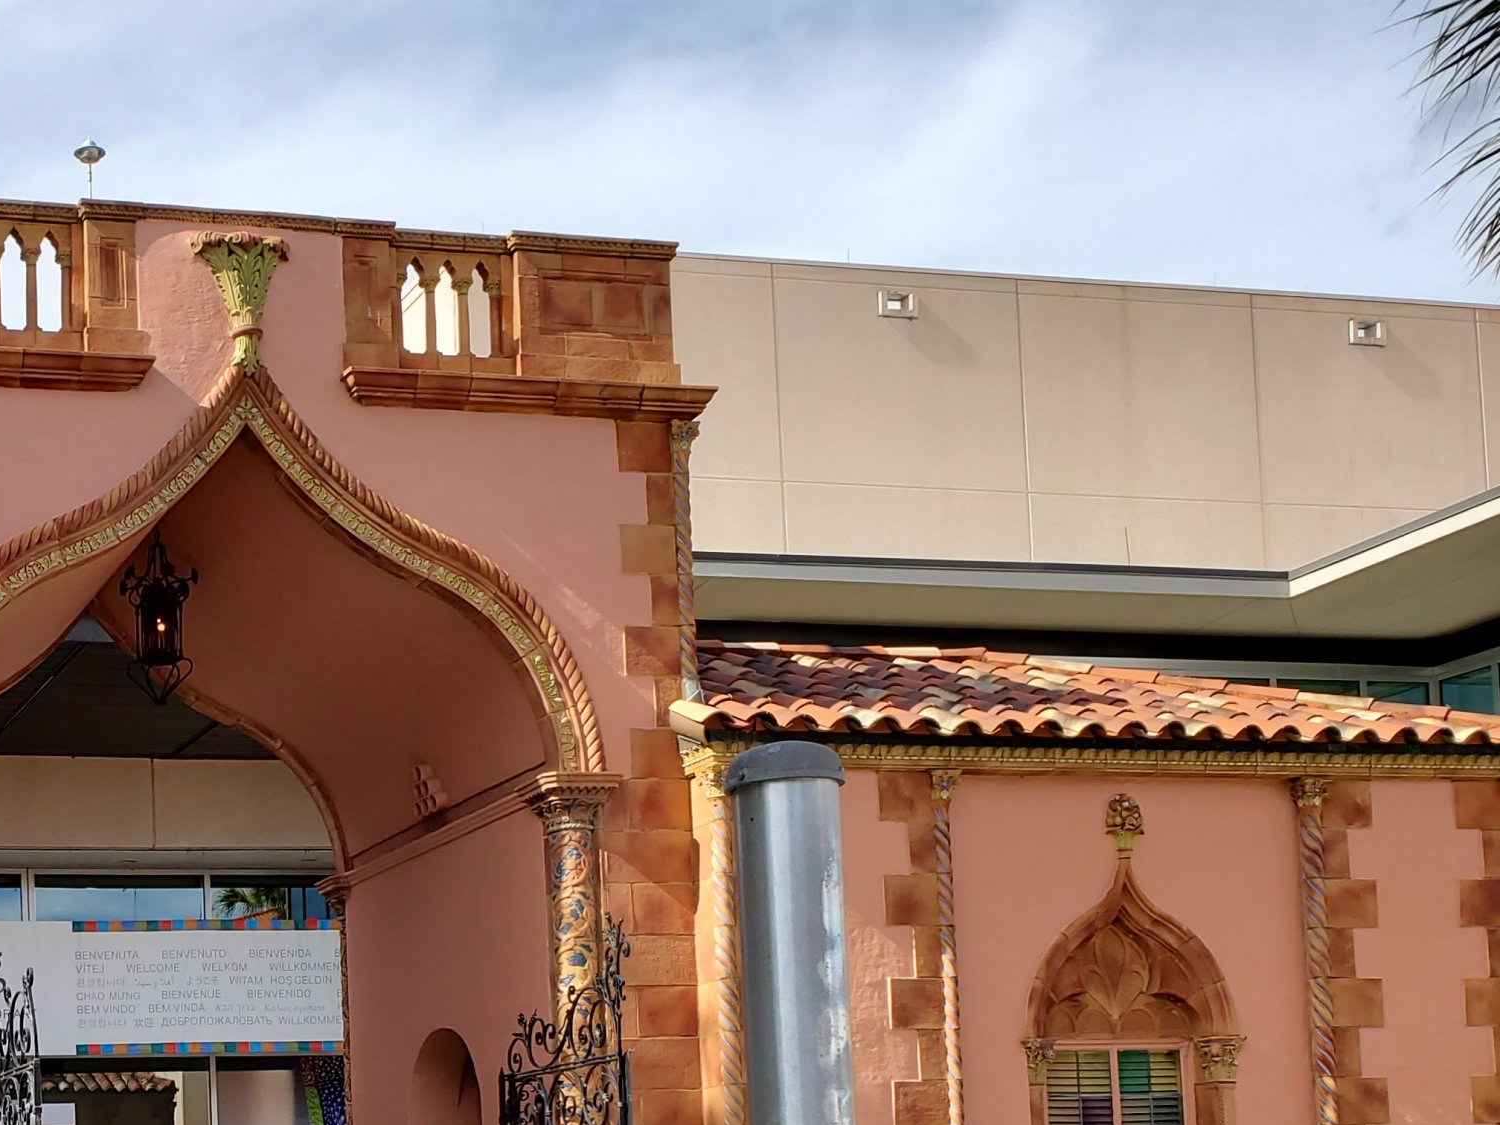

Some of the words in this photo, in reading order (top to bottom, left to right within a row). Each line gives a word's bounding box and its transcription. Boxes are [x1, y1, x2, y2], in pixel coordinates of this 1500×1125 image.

[74, 950, 140, 961] BENVENUTA
[161, 949, 227, 960] BENVENUTO
[248, 948, 312, 959] BIENVENIDA
[126, 963, 180, 973] WELCOME
[202, 962, 248, 972] WELKOM
[269, 962, 340, 972] WILLKOMMEN
[186, 976, 219, 986] ようこそ
[229, 975, 263, 985] WITAM
[161, 989, 222, 999] BIENVENUE
[247, 989, 312, 999] BIENVENIDO
[76, 1005, 100, 1015] BEM
[103, 1004, 136, 1014] VINDO
[148, 1003, 171, 1013] BEM
[172, 1003, 206, 1013] VINDA
[278, 1015, 342, 1025] WILLKOMME
